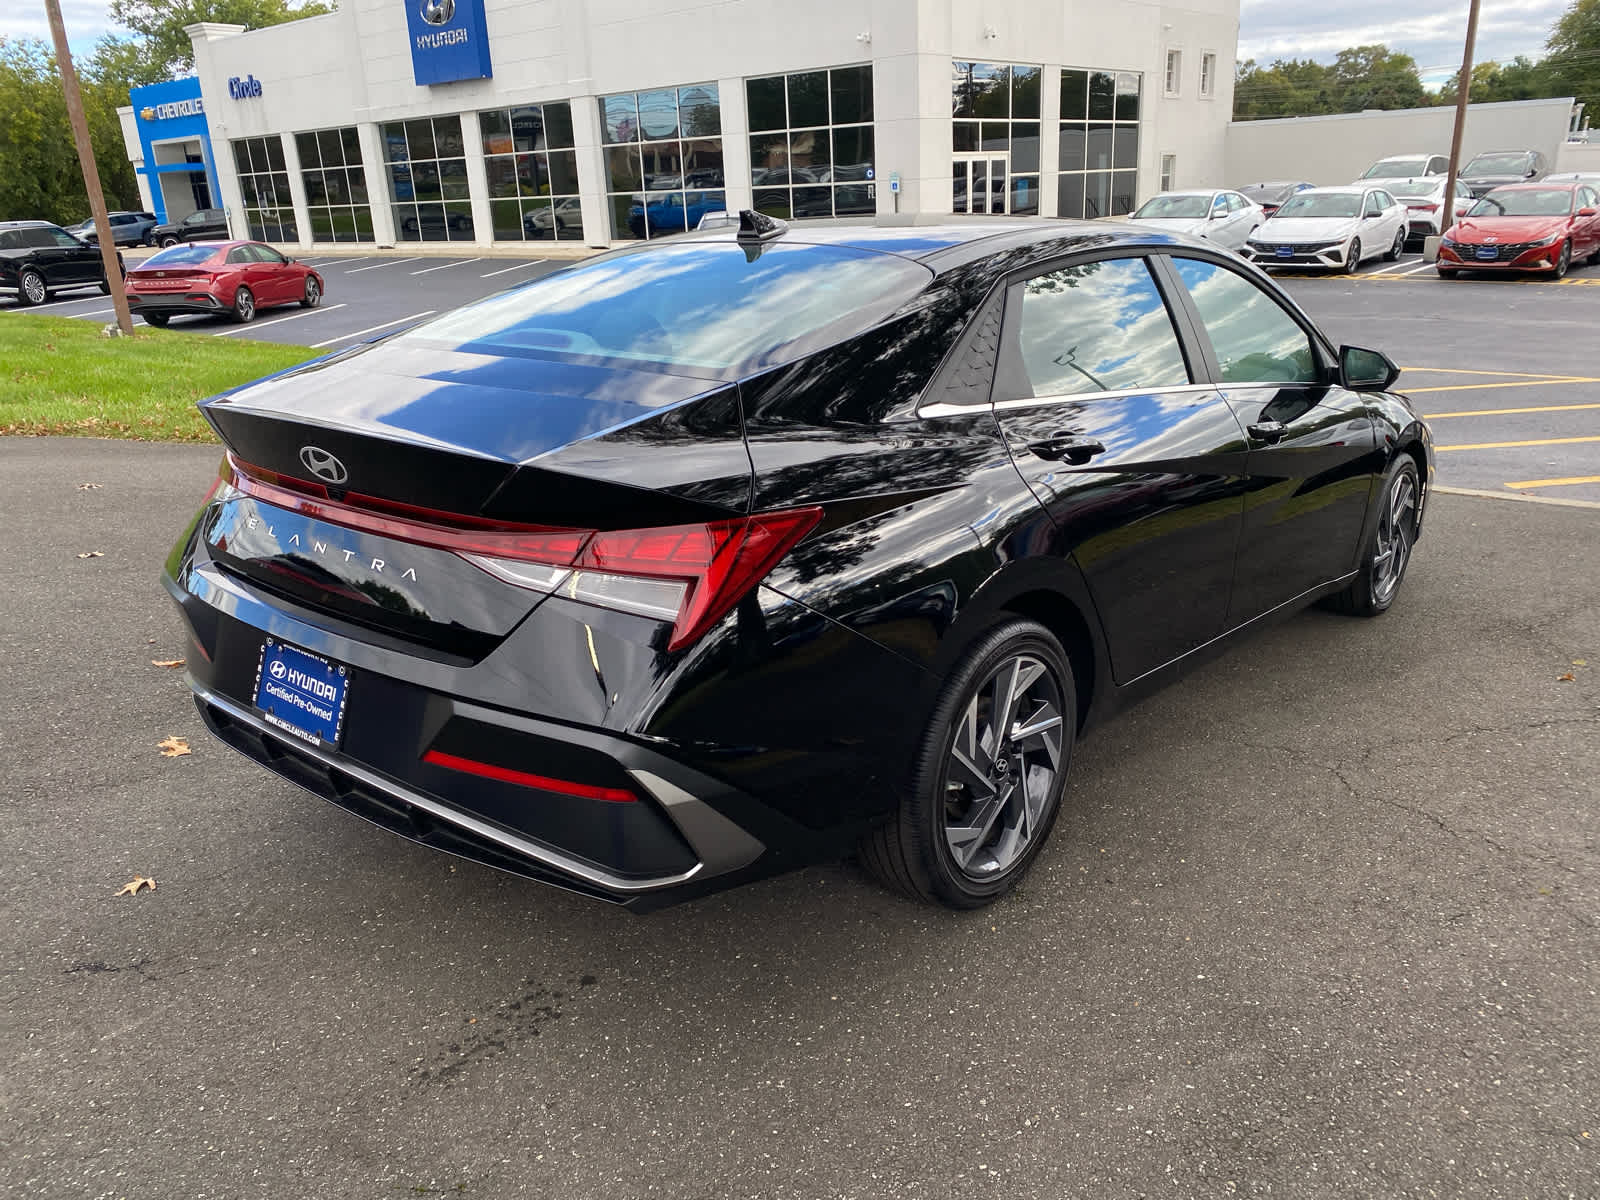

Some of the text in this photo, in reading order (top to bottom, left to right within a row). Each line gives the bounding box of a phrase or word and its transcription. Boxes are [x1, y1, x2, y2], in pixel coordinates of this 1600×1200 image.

[416, 28, 468, 49] HYUNDAI
[228, 74, 263, 100] Circle
[157, 97, 203, 120] CHEVROLE
[248, 518, 417, 582] ELANTRA
[287, 668, 337, 702] HYUNDAI
[266, 682, 332, 721] Certified Pre-Owned
